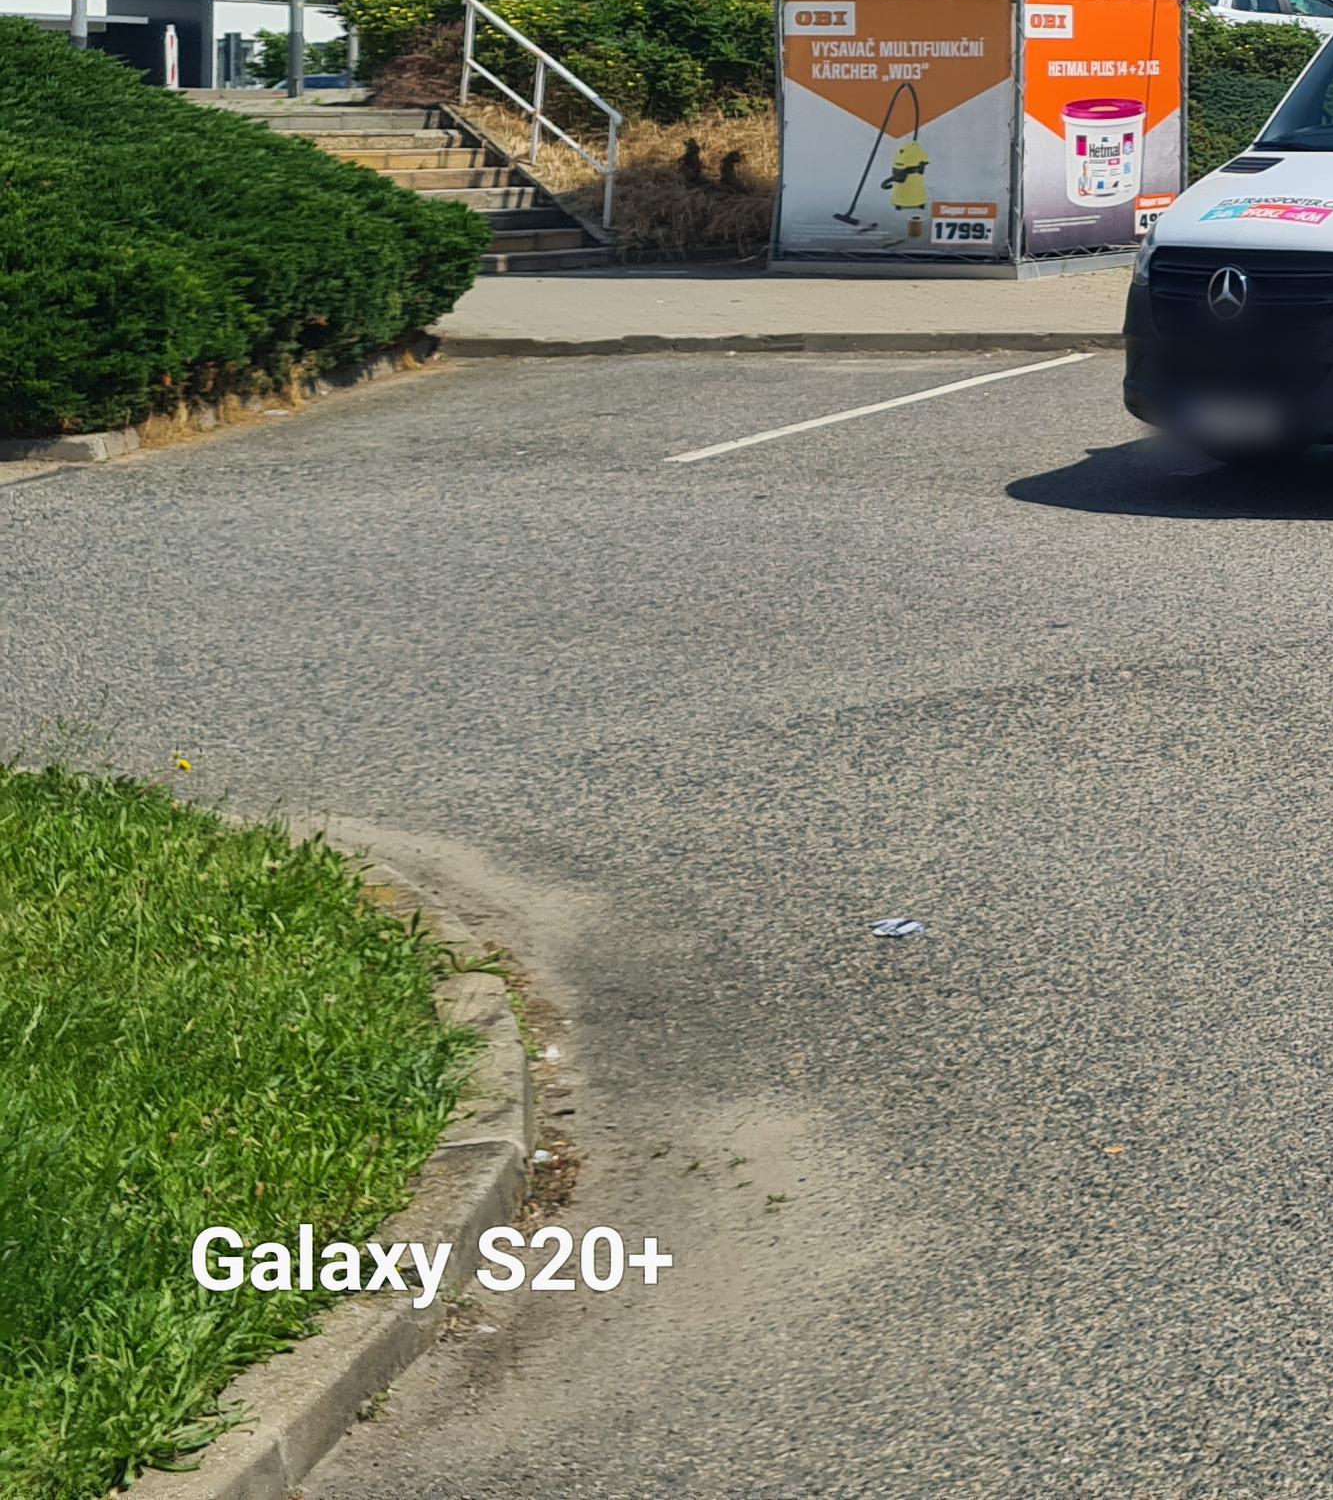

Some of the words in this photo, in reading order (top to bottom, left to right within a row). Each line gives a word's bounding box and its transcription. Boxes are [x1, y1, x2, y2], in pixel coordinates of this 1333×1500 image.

[795, 11, 847, 26] OBI
[1030, 14, 1067, 29] OBI
[811, 38, 875, 57] VYSAVAČ
[879, 37, 985, 57] MULTIFUNKČNÍ
[1048, 61, 1089, 77] HETMAL
[1091, 60, 1115, 76] PLUS
[1089, 142, 1121, 158] Hetmal
